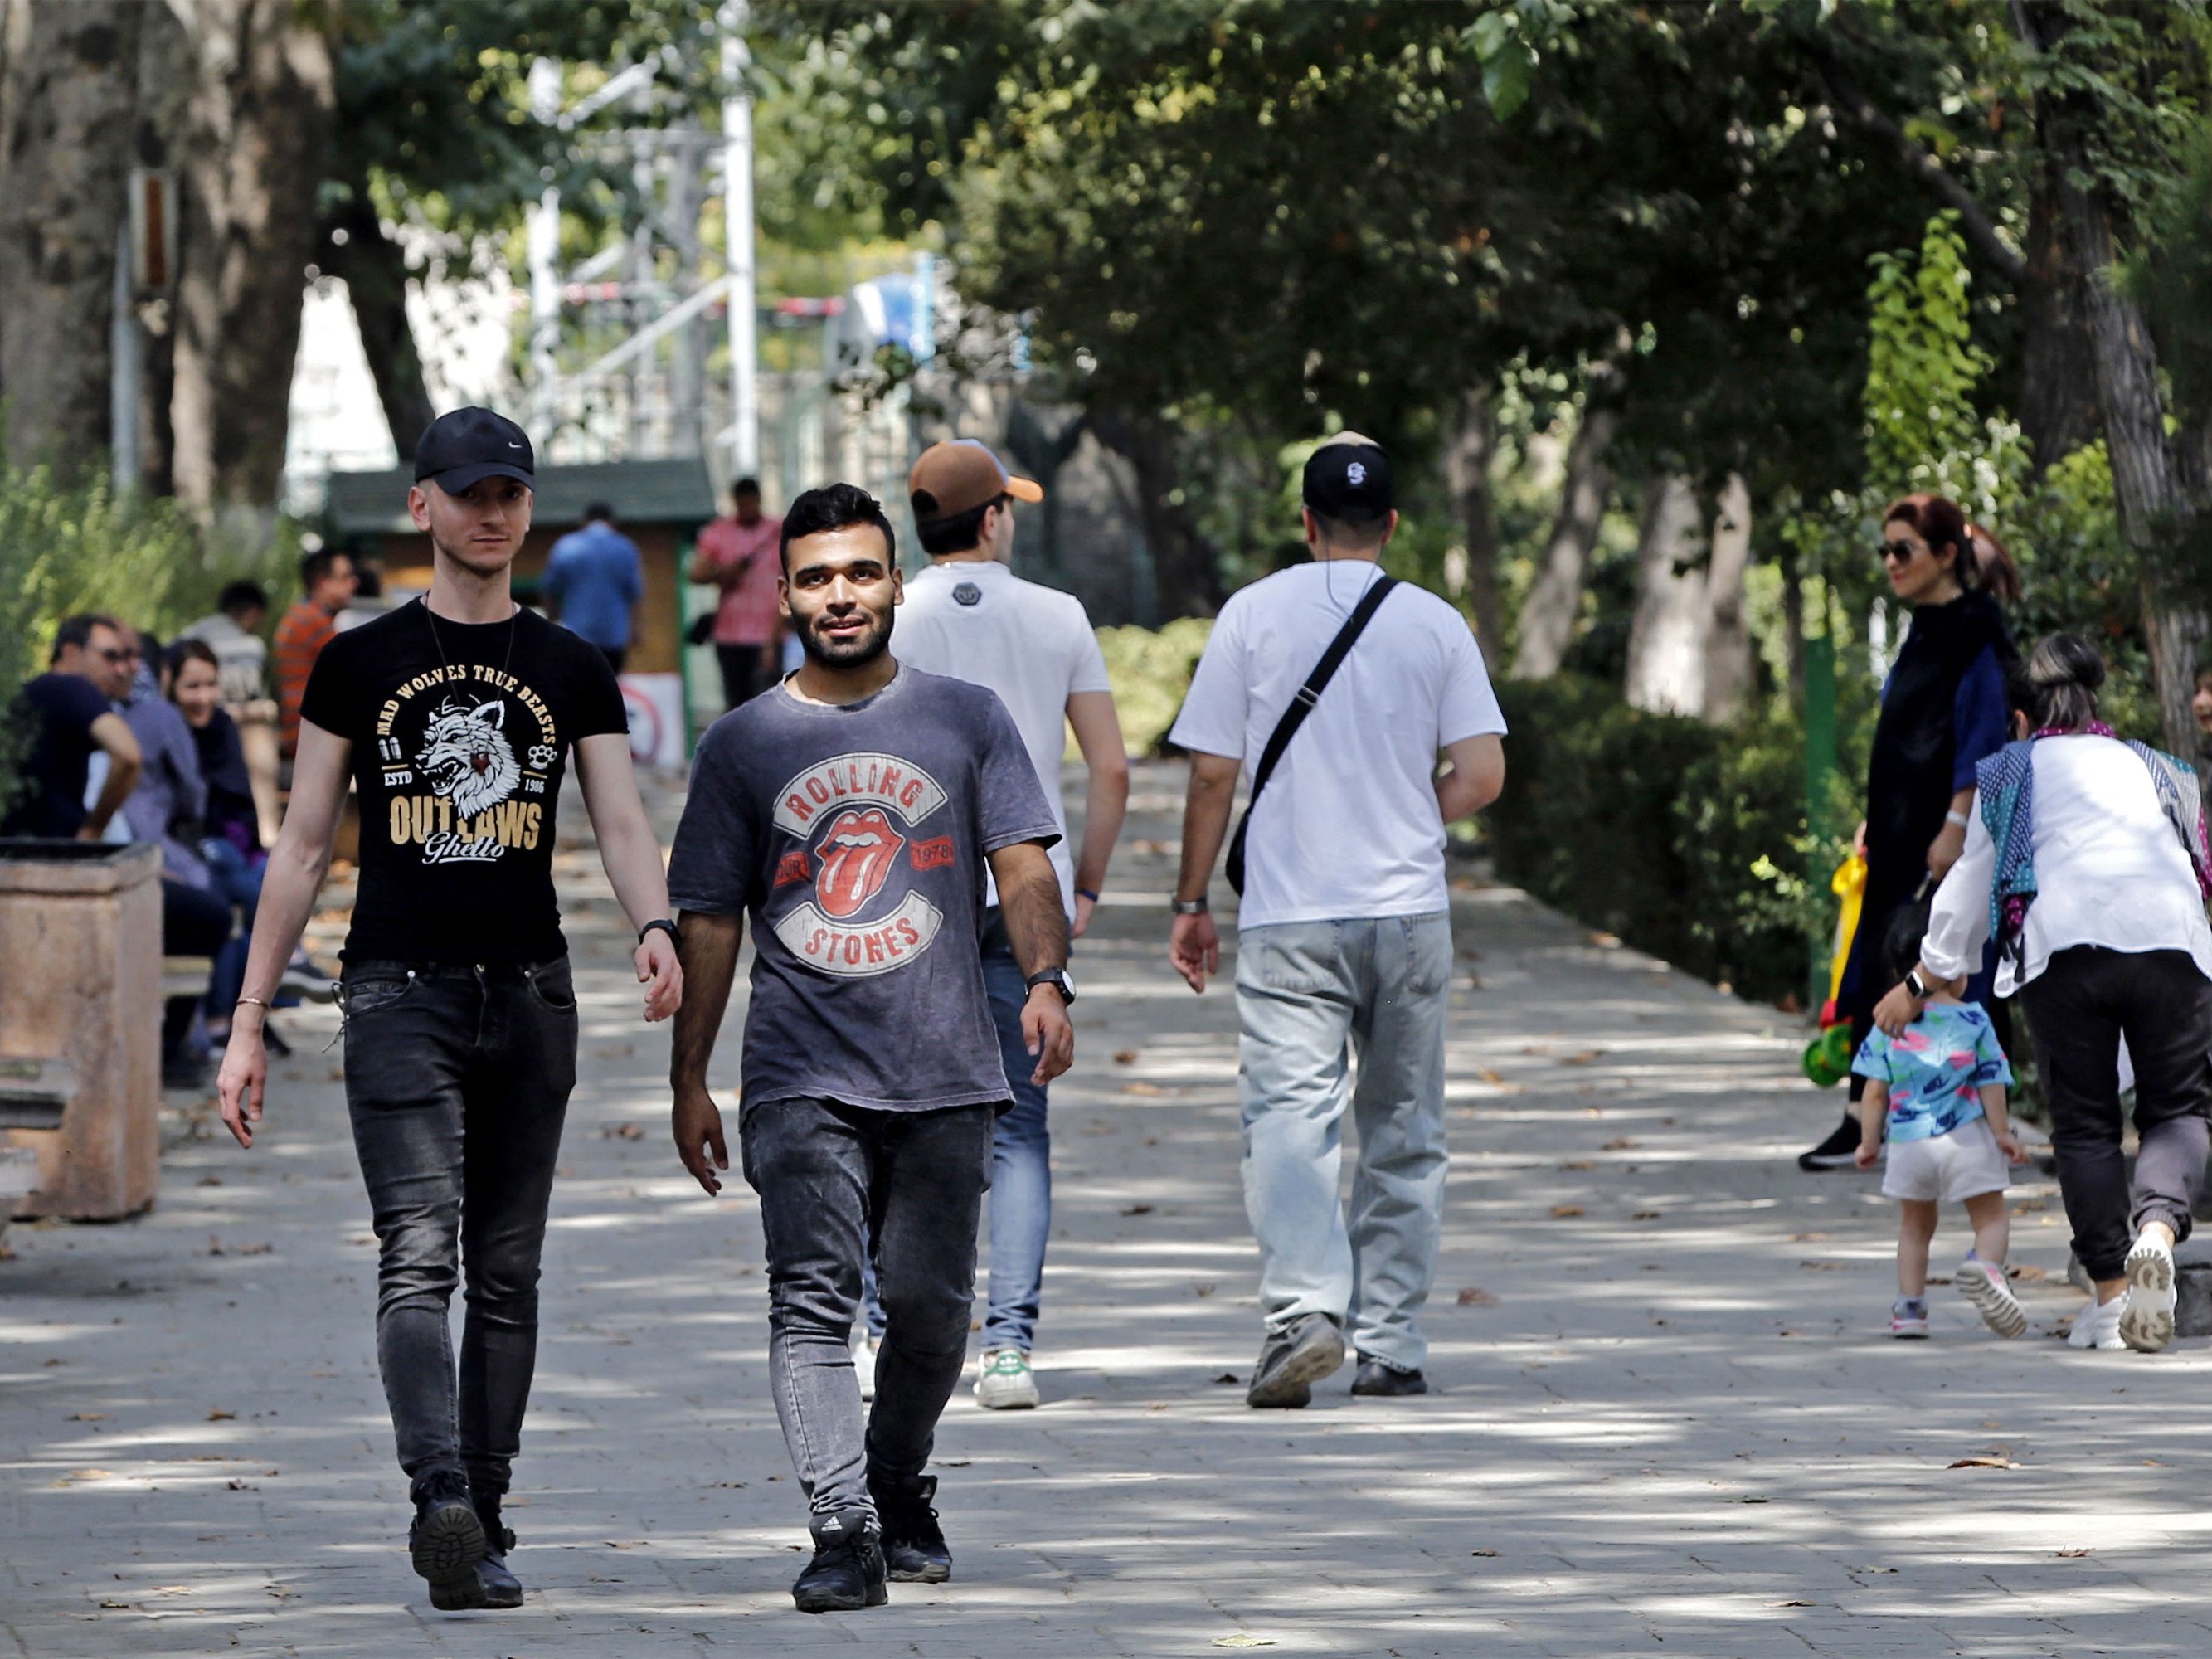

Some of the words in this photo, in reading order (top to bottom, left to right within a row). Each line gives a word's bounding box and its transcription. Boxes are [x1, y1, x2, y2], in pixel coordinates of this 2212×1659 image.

[377, 699, 400, 737] MAD
[396, 664, 467, 700] WOLVES
[473, 664, 519, 693] TRUE
[516, 685, 557, 745] BEASTS
[384, 771, 413, 786] ESTD
[785, 763, 924, 822] ROLLING
[421, 830, 505, 865] Ghetto
[915, 844, 950, 863] 1978
[805, 917, 920, 966] STONES
